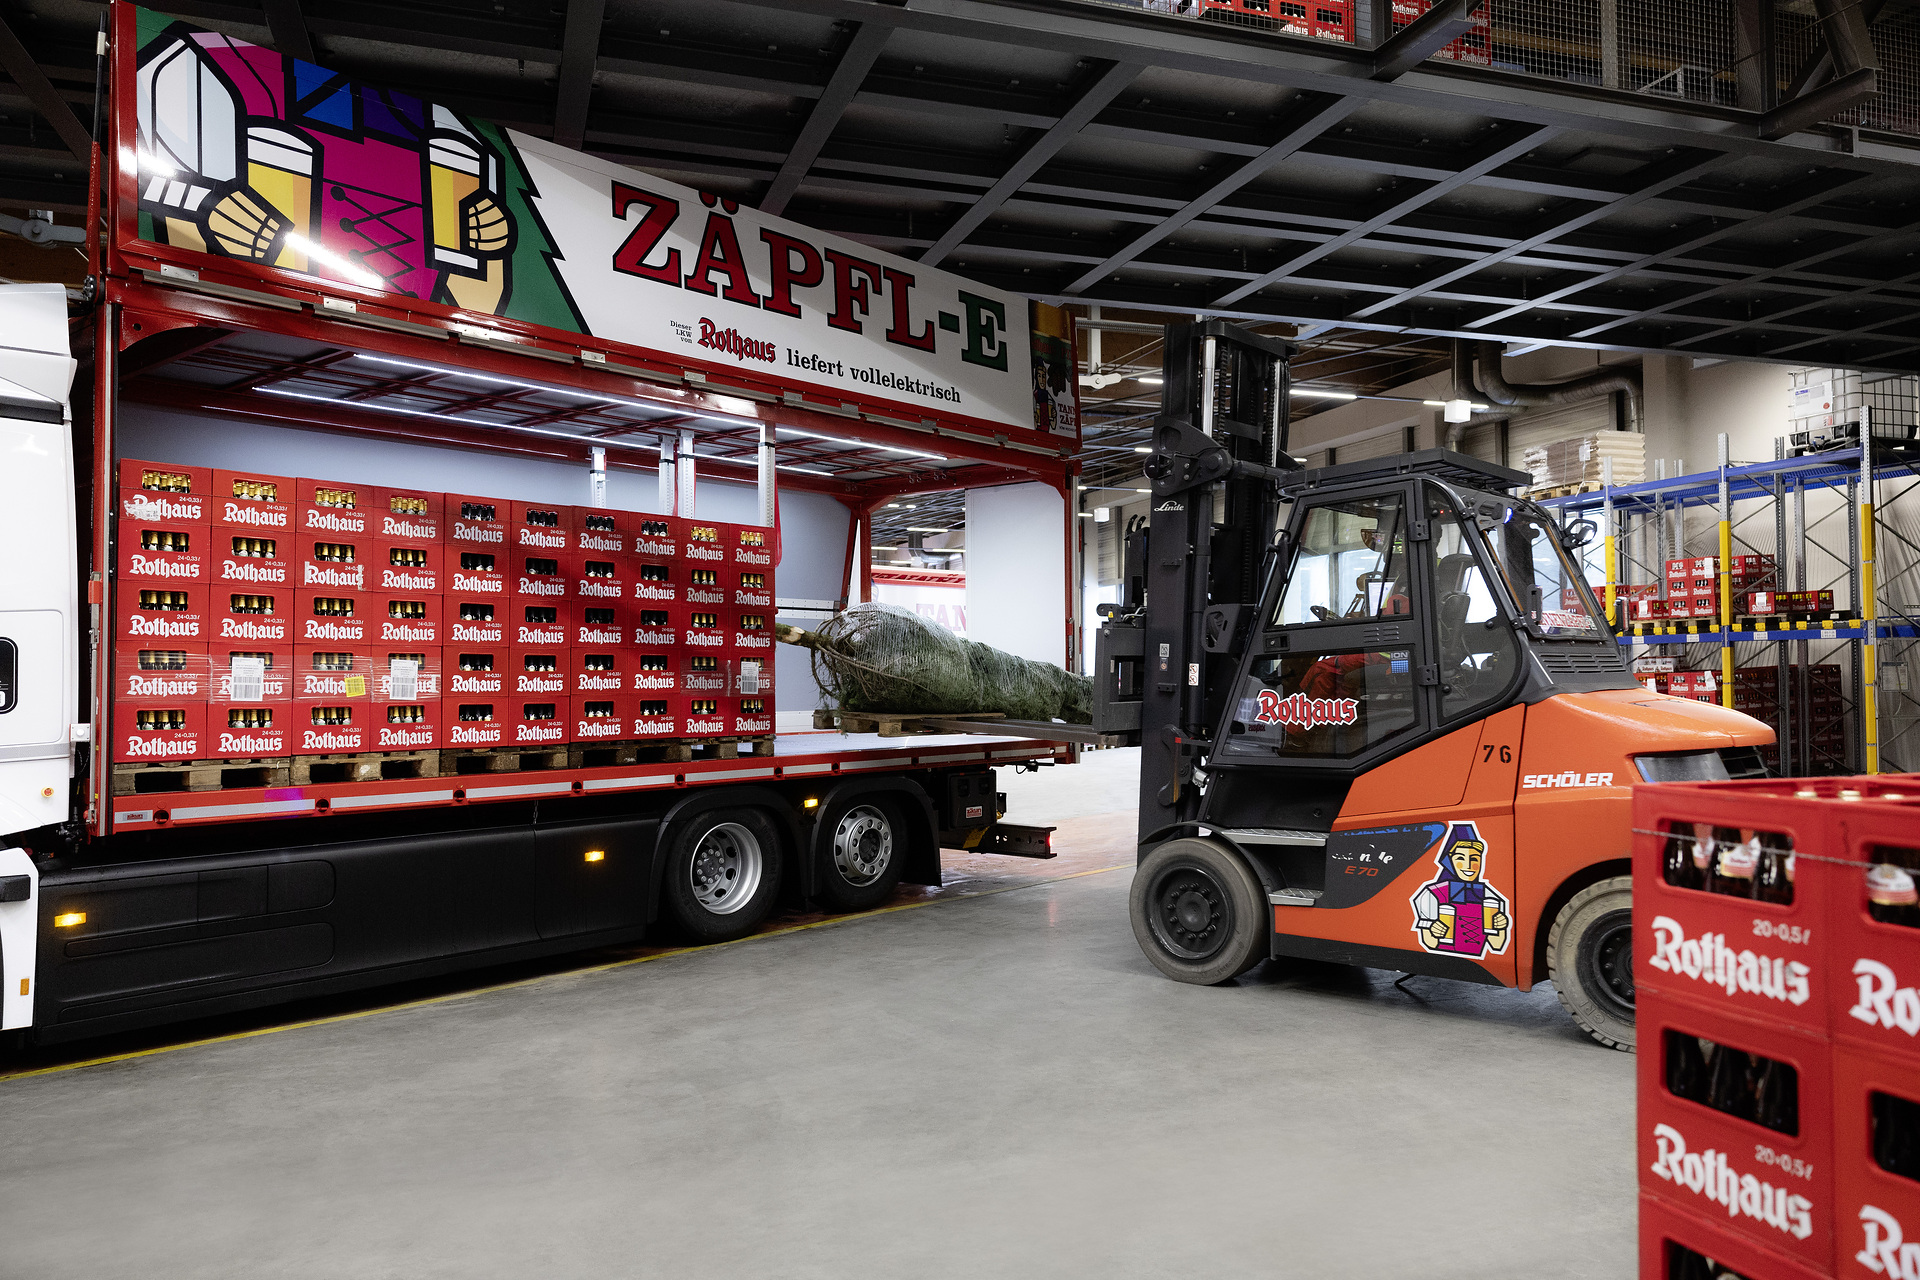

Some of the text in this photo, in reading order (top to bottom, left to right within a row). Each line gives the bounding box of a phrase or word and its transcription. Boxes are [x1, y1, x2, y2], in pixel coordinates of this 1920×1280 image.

[611, 179, 1008, 373] ZÄPFL-E
[670, 320, 692, 331] Dieser
[675, 328, 693, 338] LKW
[697, 316, 776, 363] Rothaus
[786, 348, 961, 403] liefert vollelektrisch
[223, 503, 287, 526] Rothaus
[1154, 500, 1184, 513] Linde
[305, 509, 365, 532] Rothaus
[382, 517, 436, 538] Rothaus
[453, 522, 503, 543] Rothaus
[519, 529, 565, 548] Rothaus
[579, 533, 622, 551] Rothaus
[635, 538, 675, 556] Rothaus
[686, 544, 723, 561] Rothaus
[735, 548, 770, 565] Rothaus
[129, 554, 200, 578] Rothaus
[221, 560, 285, 583] Rothaus
[381, 570, 435, 590] Rothaus
[452, 573, 502, 593] Rothaus
[518, 577, 564, 596] Rothaus
[578, 580, 621, 598] Rothaus
[635, 583, 675, 600] Rothaus
[686, 587, 724, 604] Rothaus
[735, 590, 770, 606] Rothaus
[128, 615, 199, 638] Rothaus
[220, 618, 284, 640] Rothaus
[304, 620, 363, 641] Rothaus
[381, 622, 435, 642] Rothaus
[451, 624, 501, 643] Rothaus
[578, 627, 621, 644] Rothaus
[518, 627, 564, 645] Rothaus
[635, 628, 675, 645] Rothaus
[685, 630, 723, 647] Rothaus
[735, 632, 770, 648] Rothaus
[127, 676, 198, 698] Rothaus
[304, 676, 346, 695] Rotha
[451, 675, 501, 693] Rothaus
[517, 675, 563, 693] Rothaus
[578, 674, 621, 691] Rothaus
[634, 674, 674, 690] Rothaus
[686, 674, 723, 690] Rothaus
[1256, 690, 1358, 729] Rothaus
[516, 725, 562, 741] Rothaus
[578, 721, 621, 737] Rothaus
[634, 719, 674, 735] Rothaus
[686, 719, 723, 734] Rothaus
[735, 717, 770, 732] Rothaus
[218, 733, 282, 754] Rothaus
[302, 731, 361, 750] Rothaus
[378, 728, 432, 746] Rothaus
[450, 726, 500, 744] Rothaus
[126, 736, 197, 757] Rothaus
[1523, 771, 1613, 788] SCHÖLER
[1649, 915, 1810, 1006] Rothaus
[1651, 1123, 1813, 1240] Rothaus
